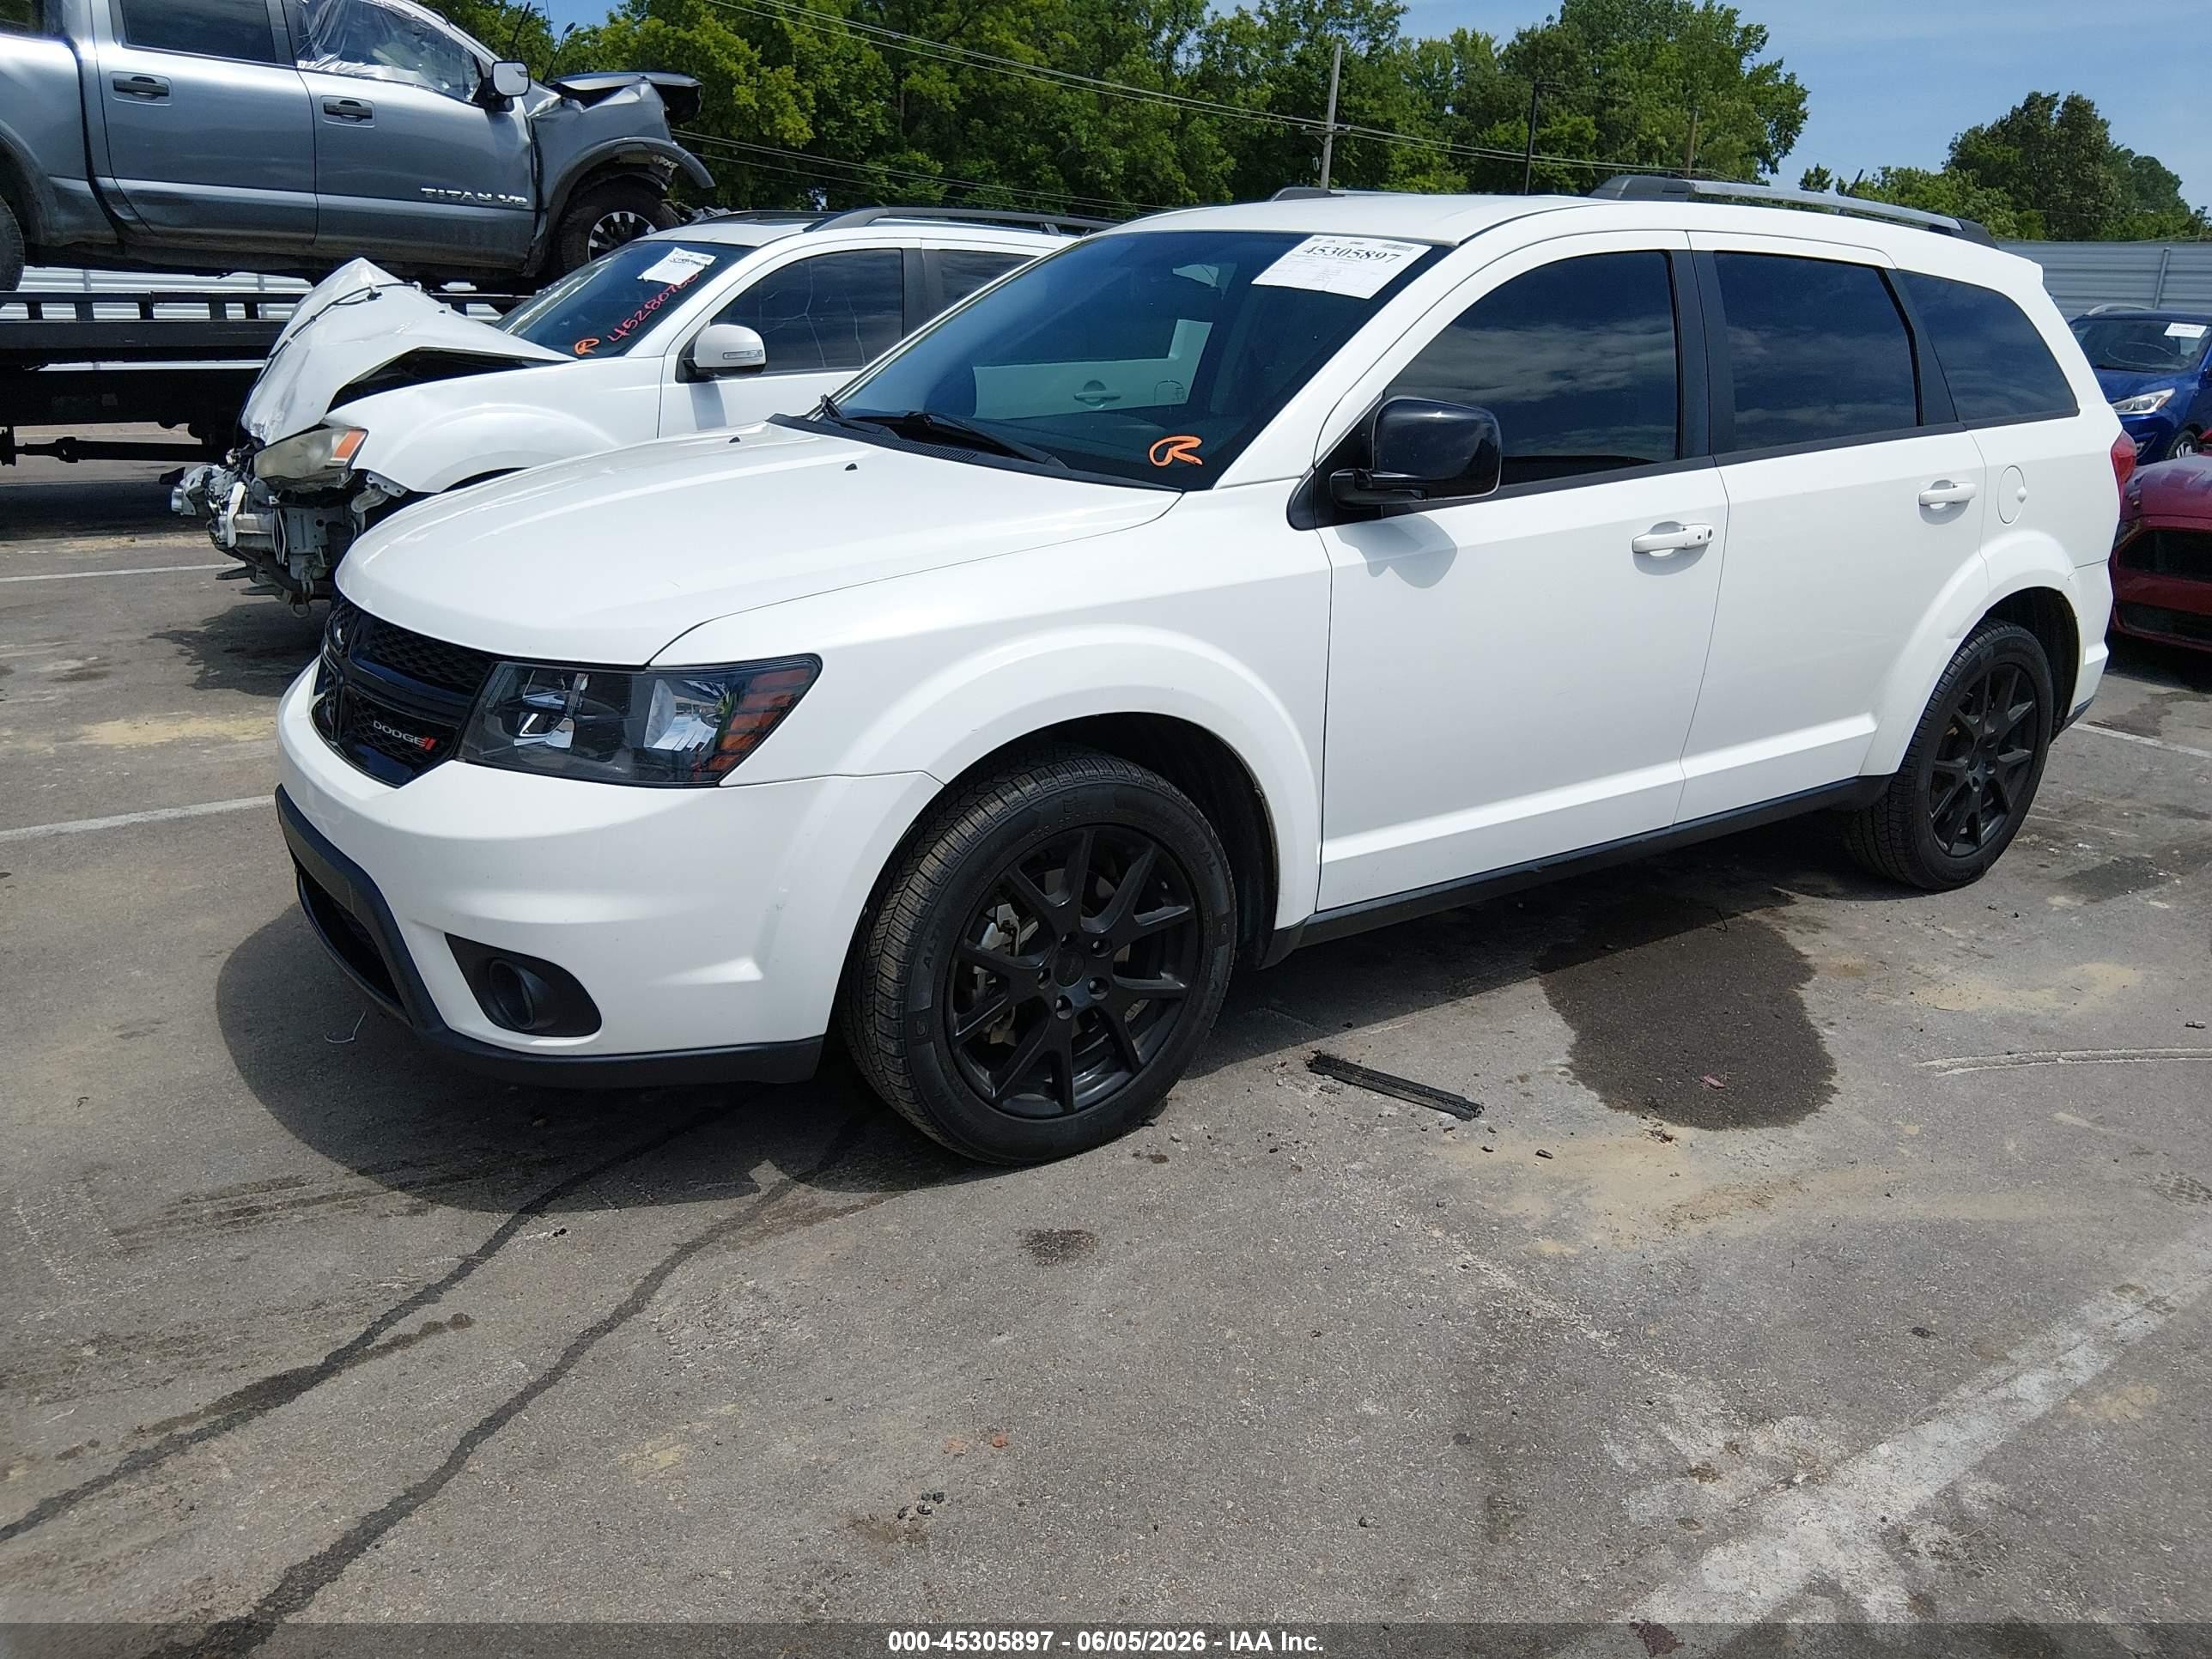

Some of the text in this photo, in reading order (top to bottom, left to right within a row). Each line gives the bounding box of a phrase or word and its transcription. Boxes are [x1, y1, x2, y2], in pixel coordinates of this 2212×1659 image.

[420, 187, 493, 202] TITAN
[1304, 245, 1401, 264] 45305897
[373, 720, 427, 748] DODGE
